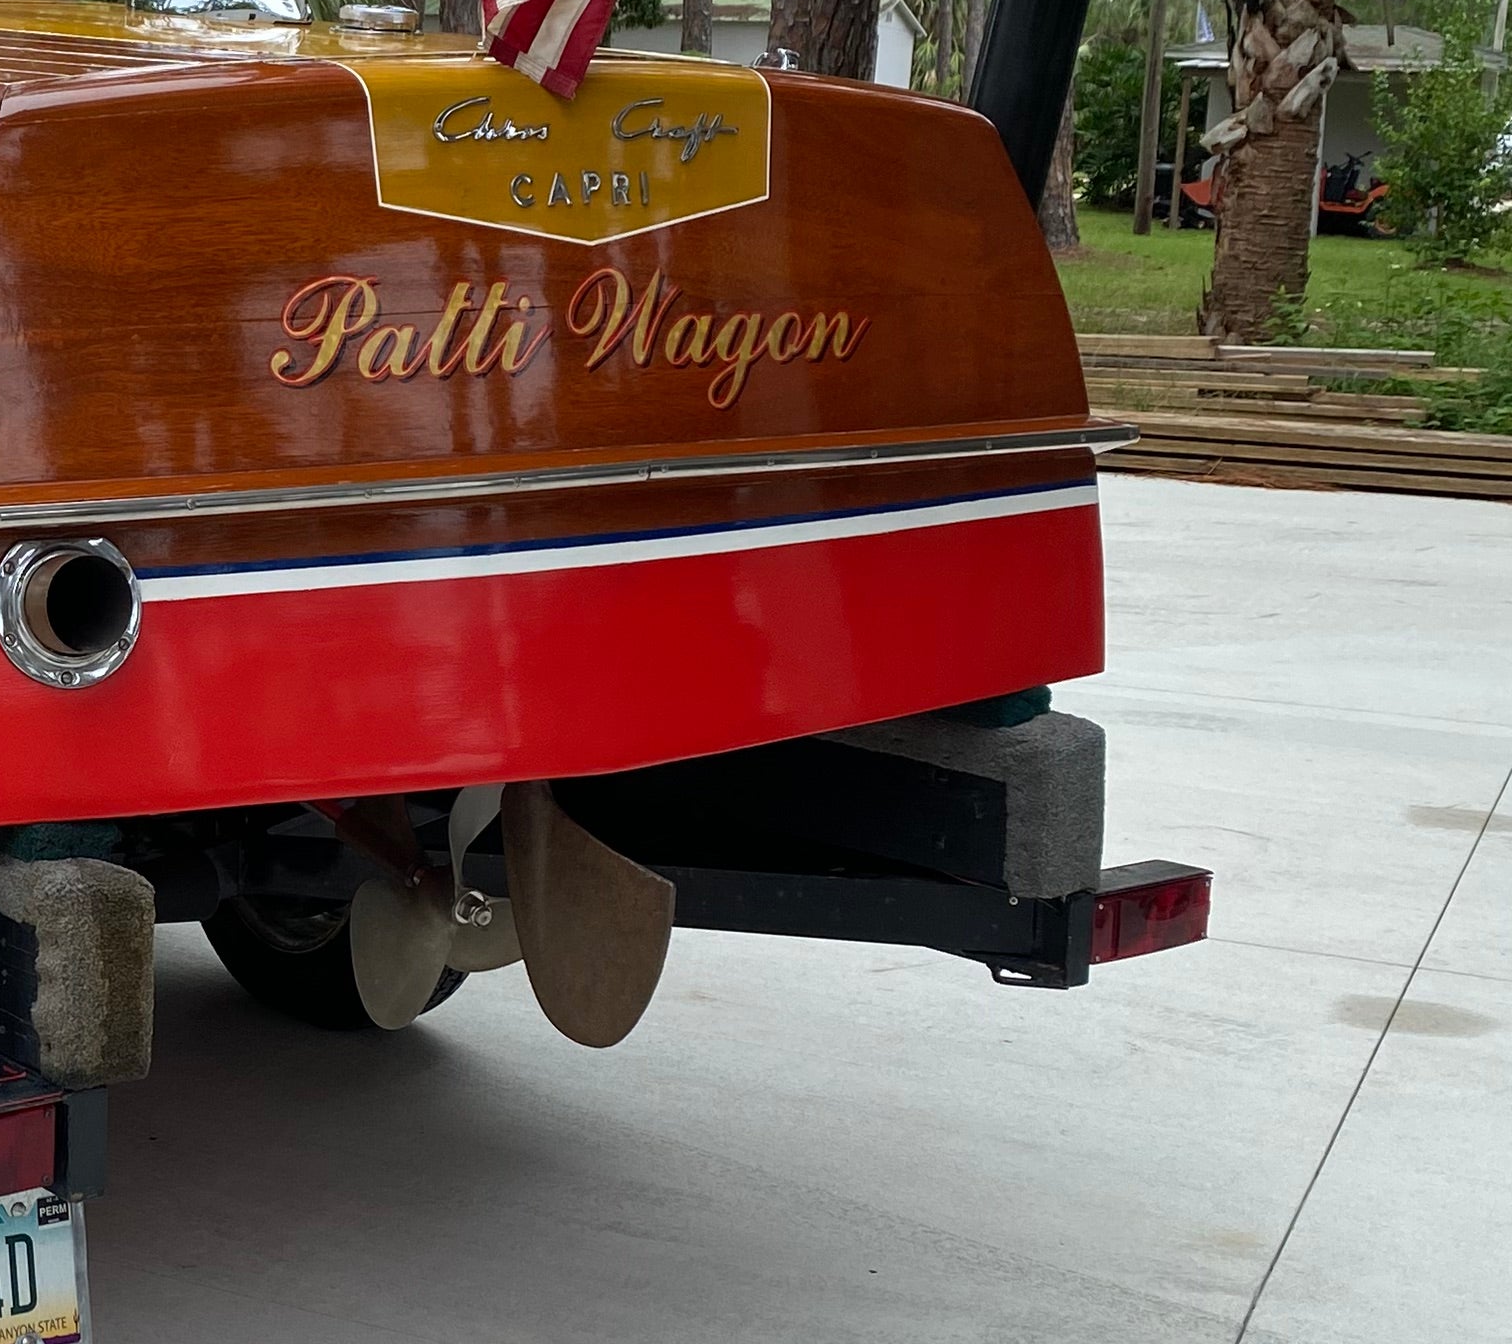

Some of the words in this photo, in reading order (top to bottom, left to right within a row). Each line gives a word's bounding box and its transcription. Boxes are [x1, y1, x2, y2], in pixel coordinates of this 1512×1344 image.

[611, 97, 739, 163] Craft
[509, 170, 650, 208] CAPRI
[269, 274, 553, 388] Patti
[566, 265, 870, 411] Wagon
[39, 1202, 67, 1218] PERM
[38, 1317, 68, 1334] STATE
